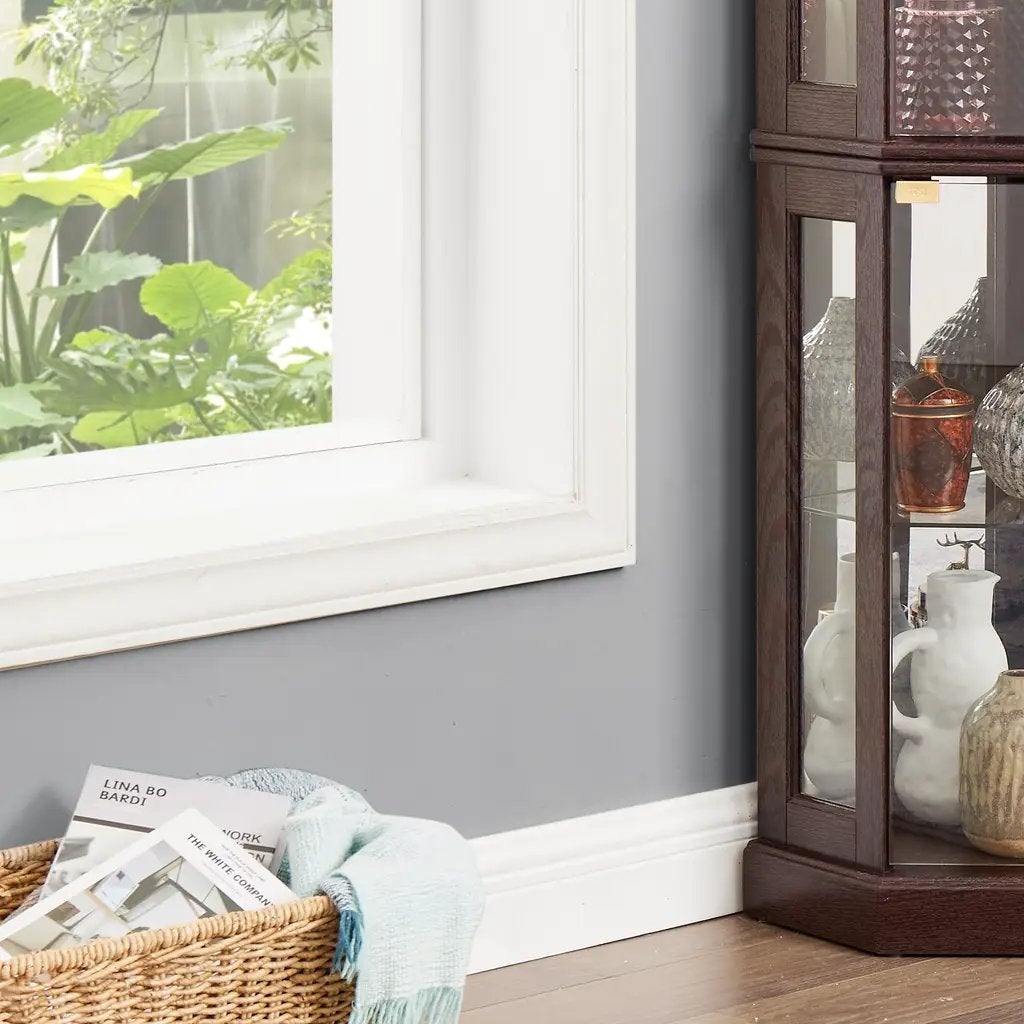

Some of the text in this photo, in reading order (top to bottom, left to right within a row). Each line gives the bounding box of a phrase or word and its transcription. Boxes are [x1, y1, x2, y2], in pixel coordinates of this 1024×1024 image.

[103, 779, 168, 798] LINA BO
[99, 790, 147, 807] BARDI
[186, 833, 206, 852] THE
[205, 849, 234, 876] WHITE
[233, 872, 273, 907] COMPAN
